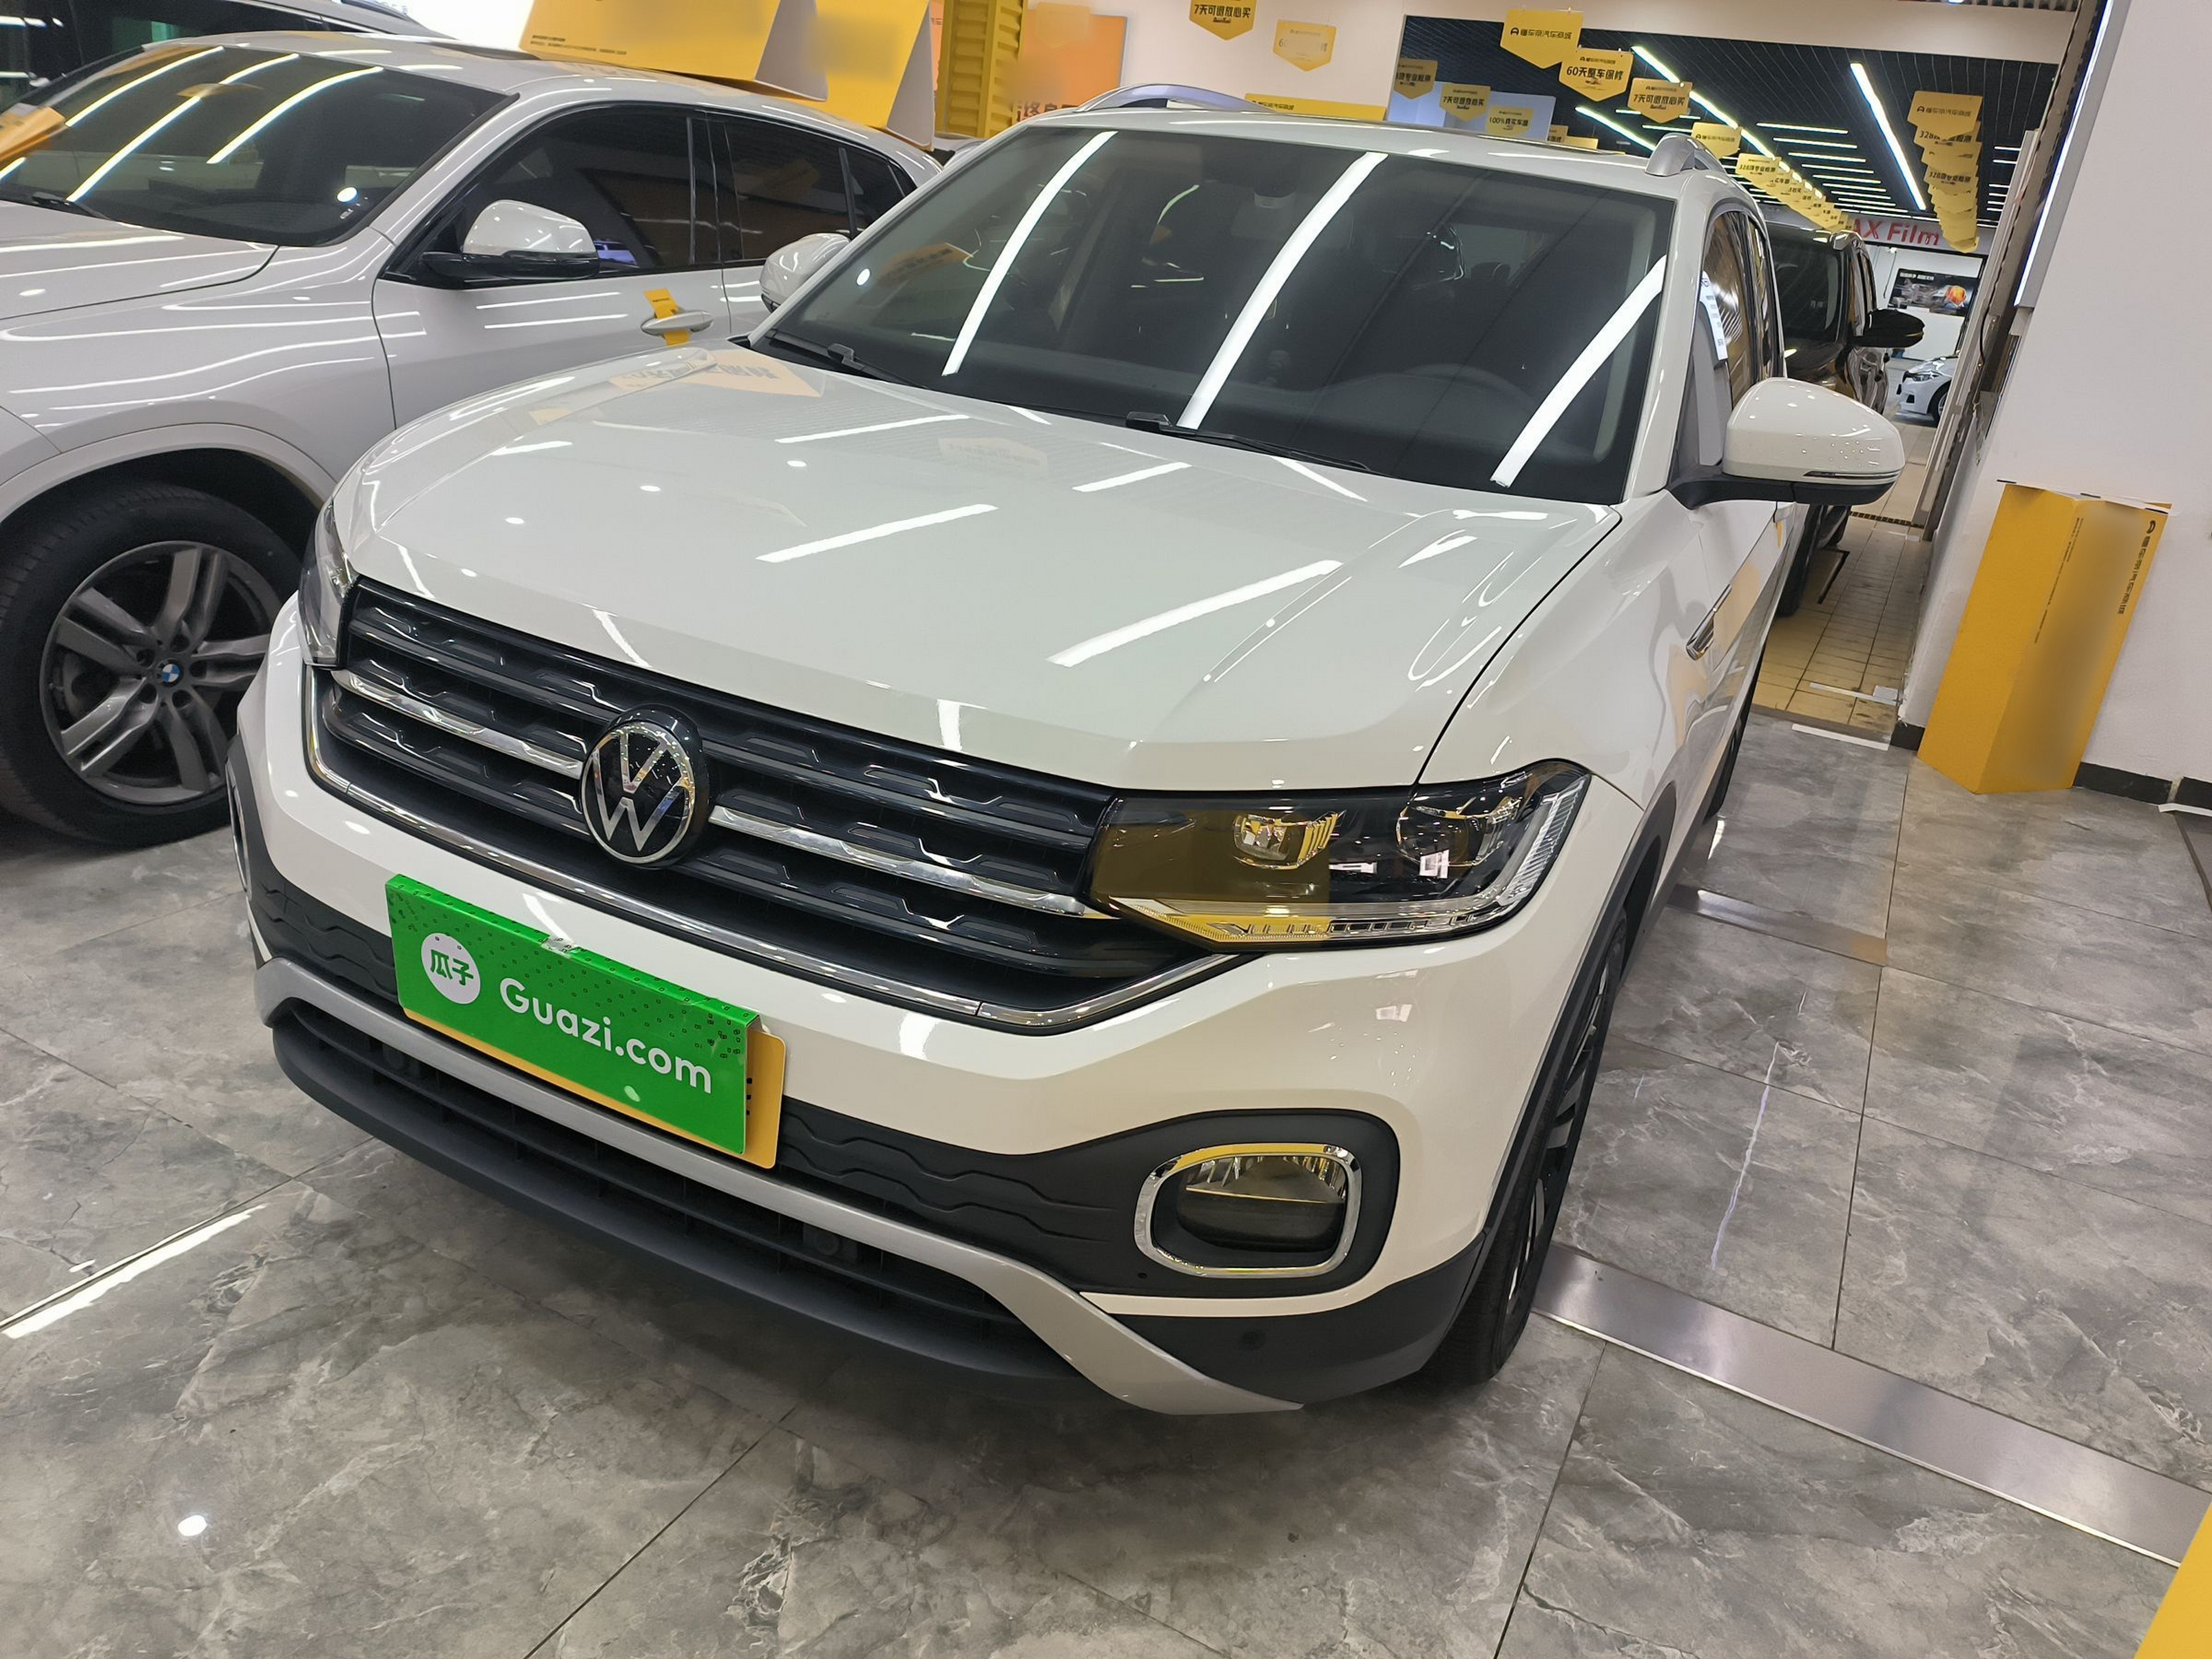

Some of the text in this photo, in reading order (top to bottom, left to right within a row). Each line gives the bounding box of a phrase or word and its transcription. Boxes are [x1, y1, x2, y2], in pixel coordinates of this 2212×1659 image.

[1887, 222, 1940, 246] Film
[429, 949, 474, 987] 瓜子
[499, 977, 713, 1094] Guazi.com
